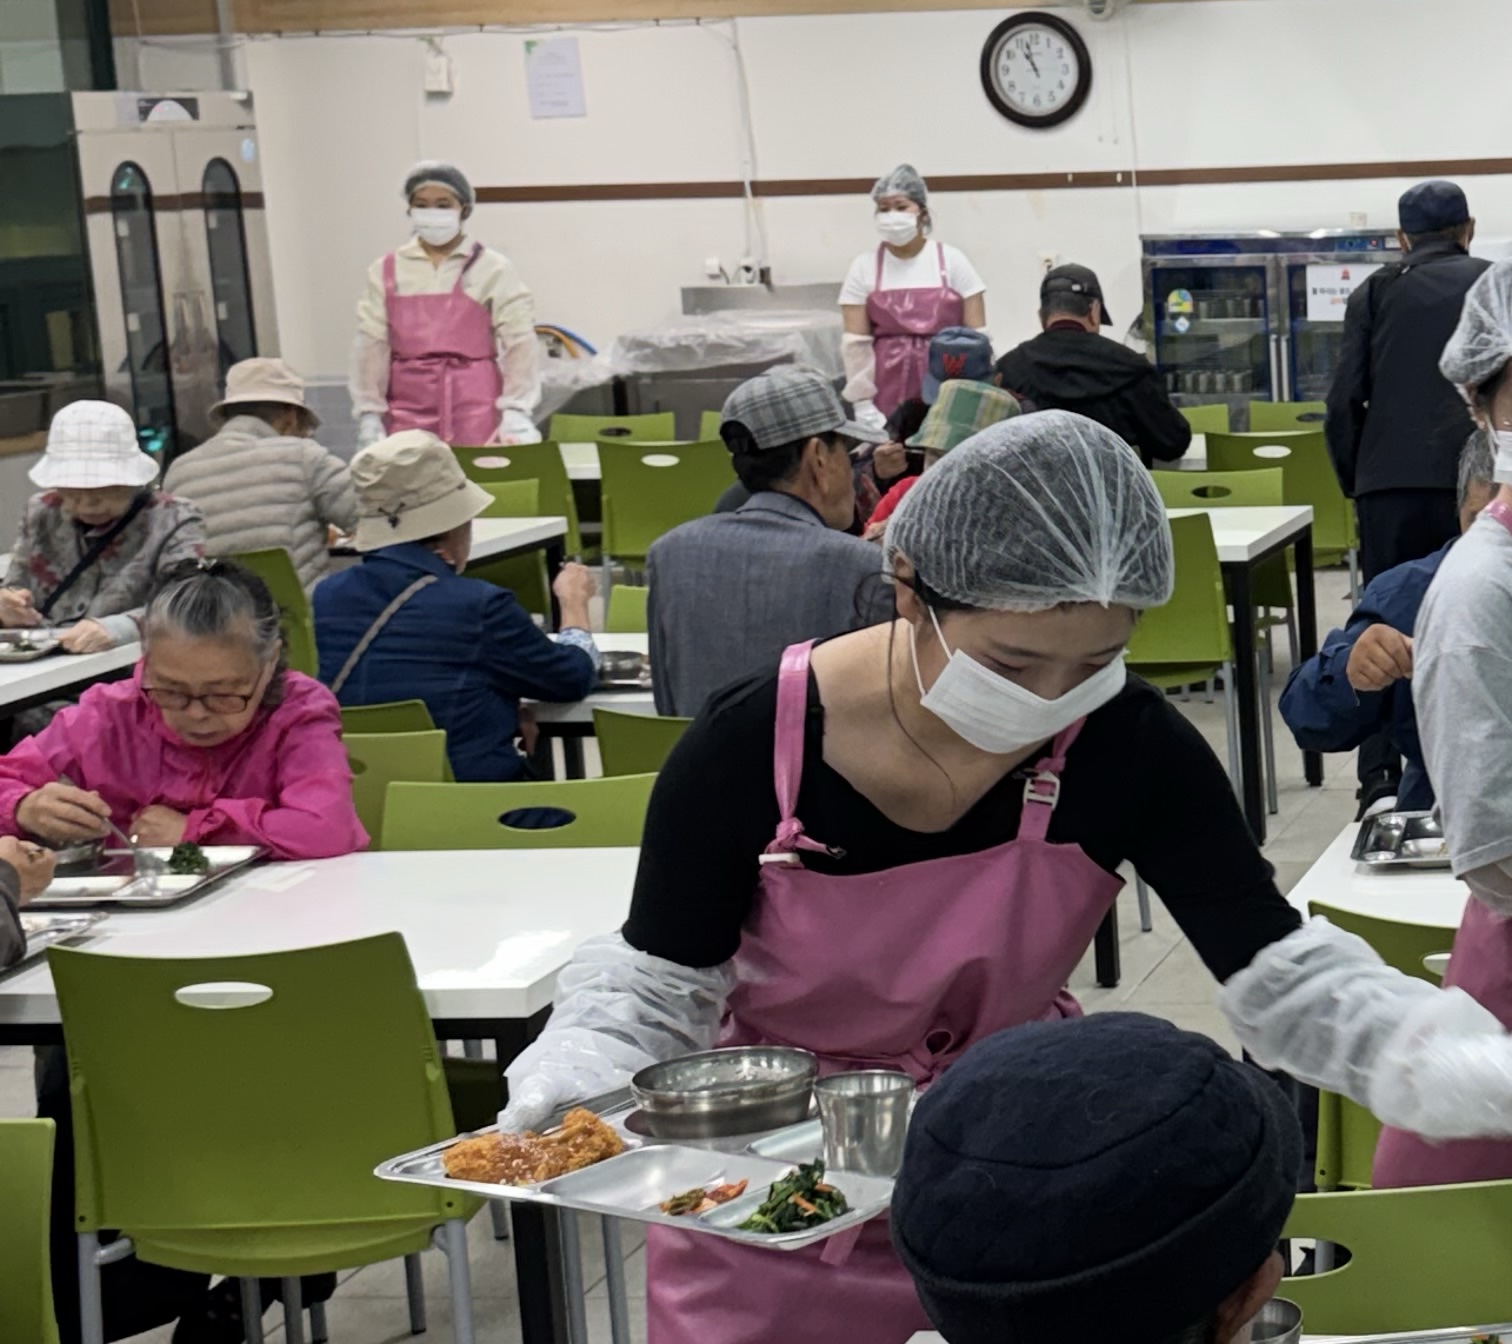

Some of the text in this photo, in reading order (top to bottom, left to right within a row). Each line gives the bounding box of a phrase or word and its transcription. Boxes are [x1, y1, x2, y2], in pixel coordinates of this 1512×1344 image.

[1016, 38, 1023, 49] 11
[1029, 32, 1040, 45] 12
[1046, 36, 1051, 49] 1
[1056, 47, 1064, 59] 2
[1001, 63, 1010, 76] 9
[1061, 63, 1069, 76] 3
[1056, 79, 1065, 90] 4
[1018, 92, 1025, 102] 7
[1033, 94, 1041, 106] 6
[1048, 90, 1056, 102] 5
